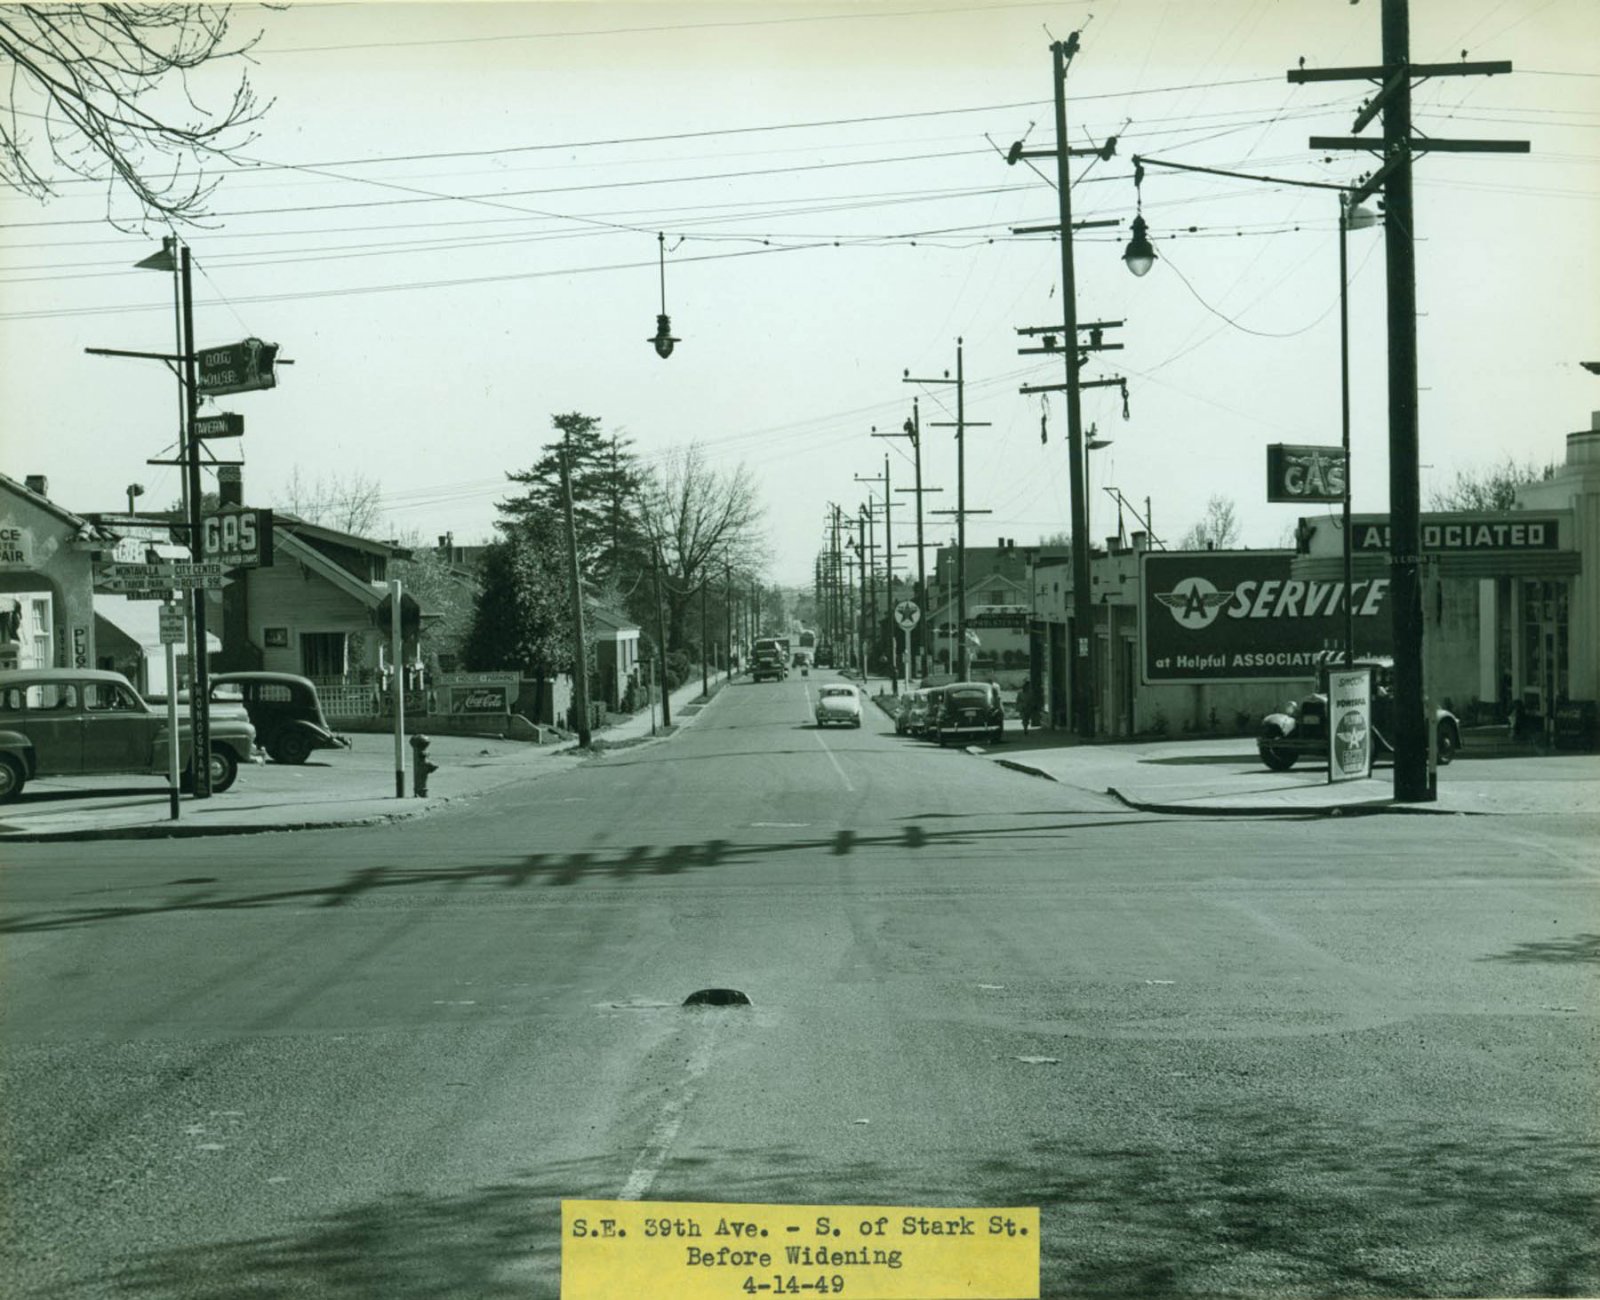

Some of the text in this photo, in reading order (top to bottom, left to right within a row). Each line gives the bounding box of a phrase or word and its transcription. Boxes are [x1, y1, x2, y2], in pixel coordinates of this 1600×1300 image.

[1285, 453, 1345, 496] GAS
[204, 513, 257, 554] GAS
[1363, 524, 1545, 548] AOCIATED
[0, 550, 25, 562] AIR
[115, 565, 159, 576] MONTAVILLA
[174, 564, 221, 575] CITY CENTER
[147, 578, 164, 588] PARK
[181, 578, 204, 588] ROUTE
[1227, 578, 1391, 618] SERVICE
[1156, 651, 1321, 670] at Helpful ASSOCIATE
